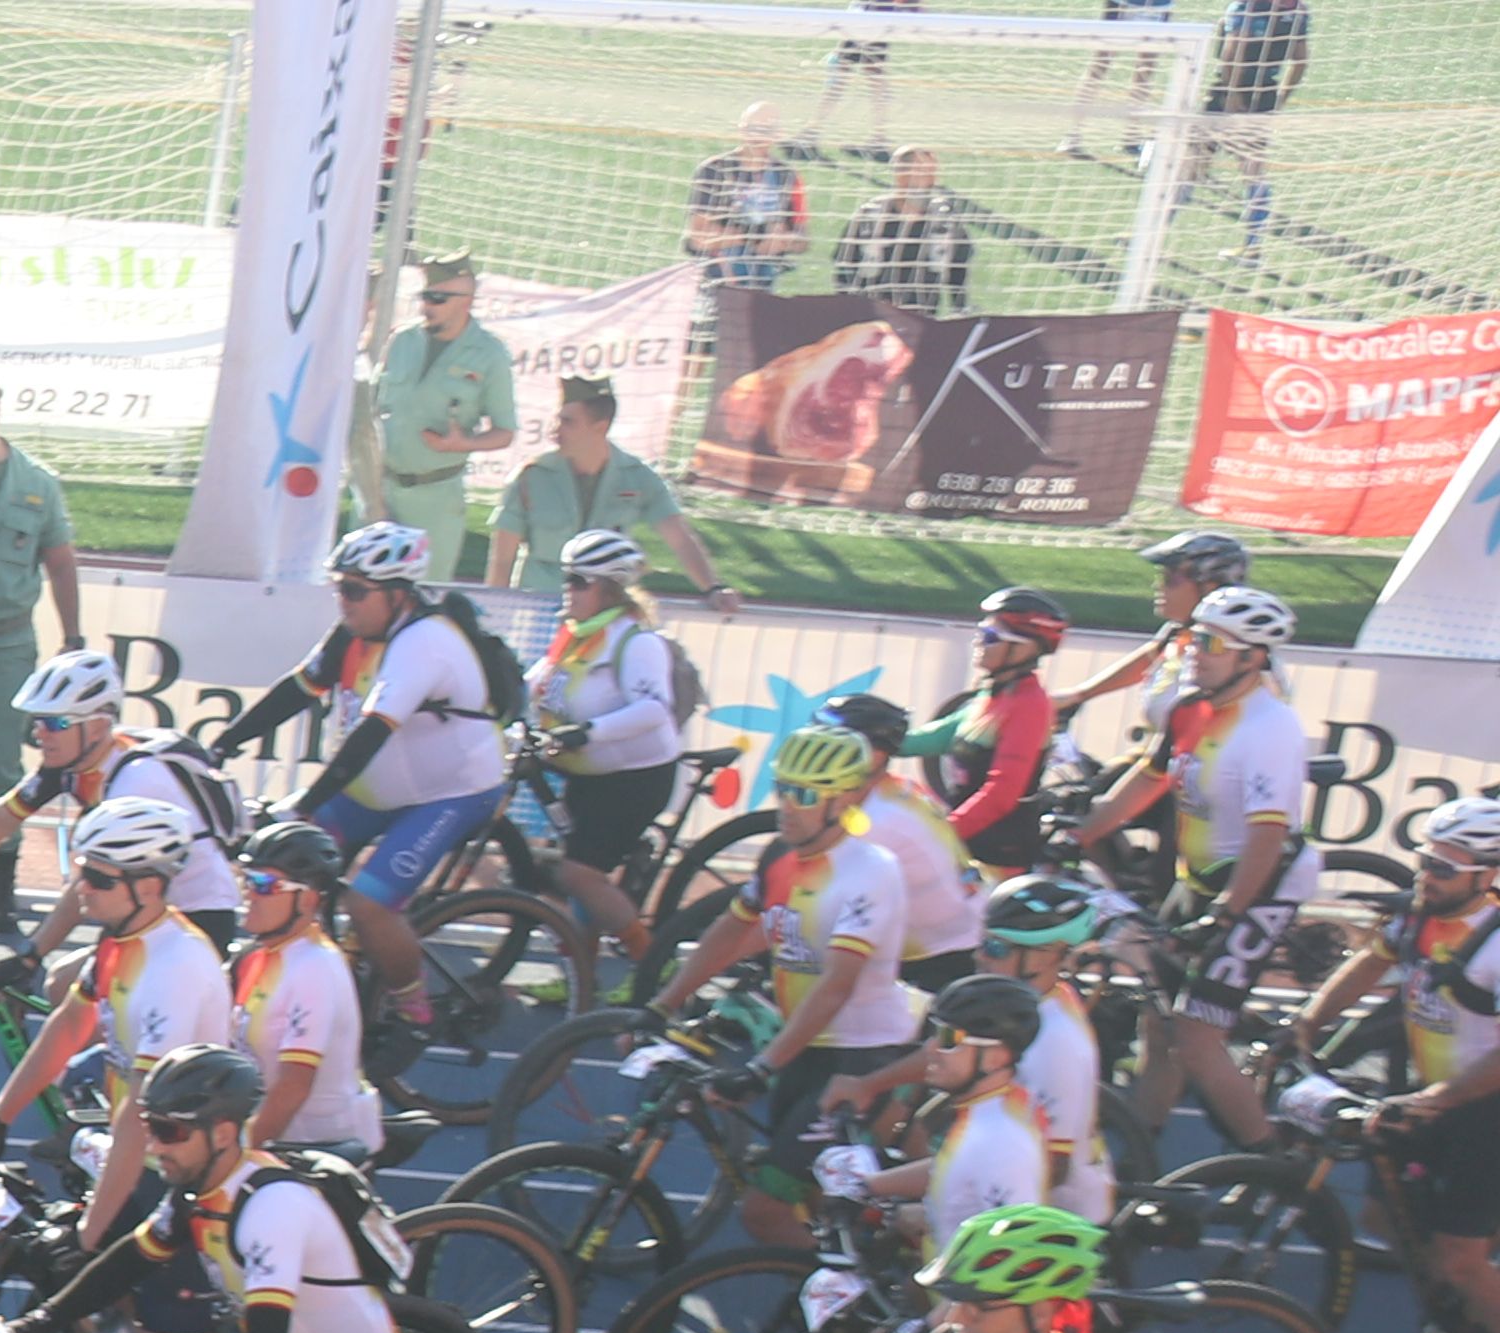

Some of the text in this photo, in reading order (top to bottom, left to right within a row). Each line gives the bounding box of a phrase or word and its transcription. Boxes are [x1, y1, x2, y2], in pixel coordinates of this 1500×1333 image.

[14, 388, 153, 417] 92 22 71
